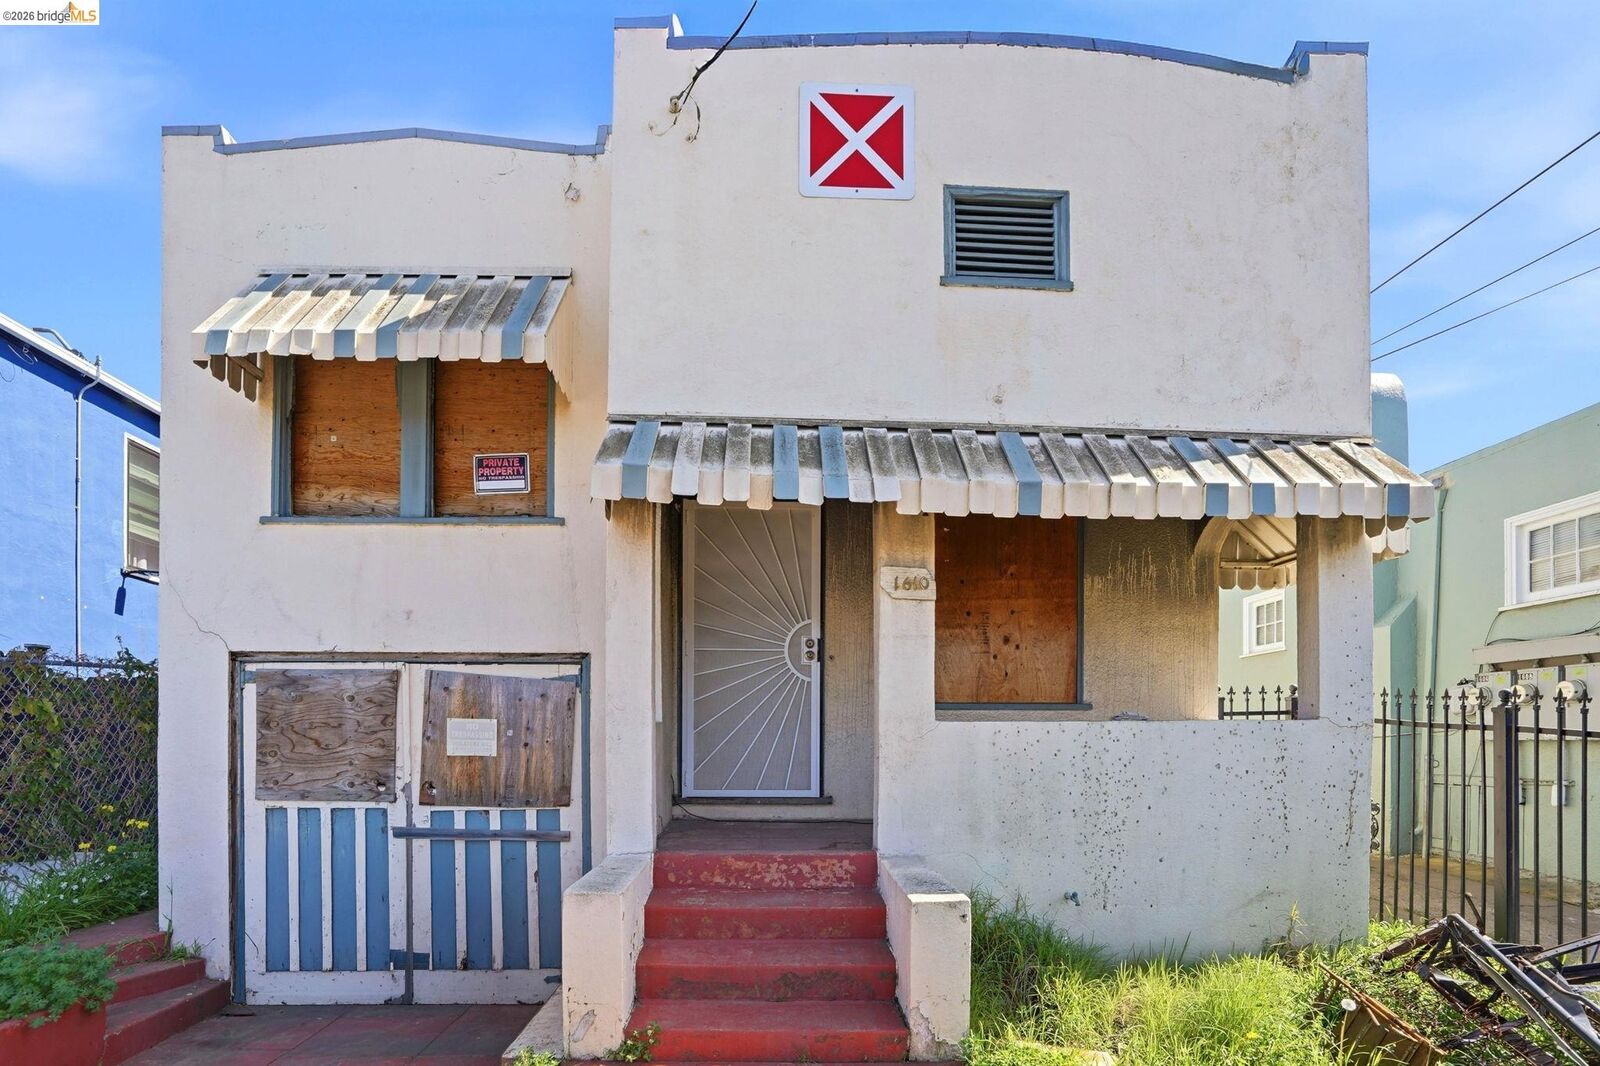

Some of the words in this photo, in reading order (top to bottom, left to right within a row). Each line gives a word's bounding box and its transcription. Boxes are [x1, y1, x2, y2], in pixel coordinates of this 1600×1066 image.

[482, 458, 520, 467] PRIVATE
[478, 467, 524, 476] PROPERTY
[894, 575, 930, 591] 1610
